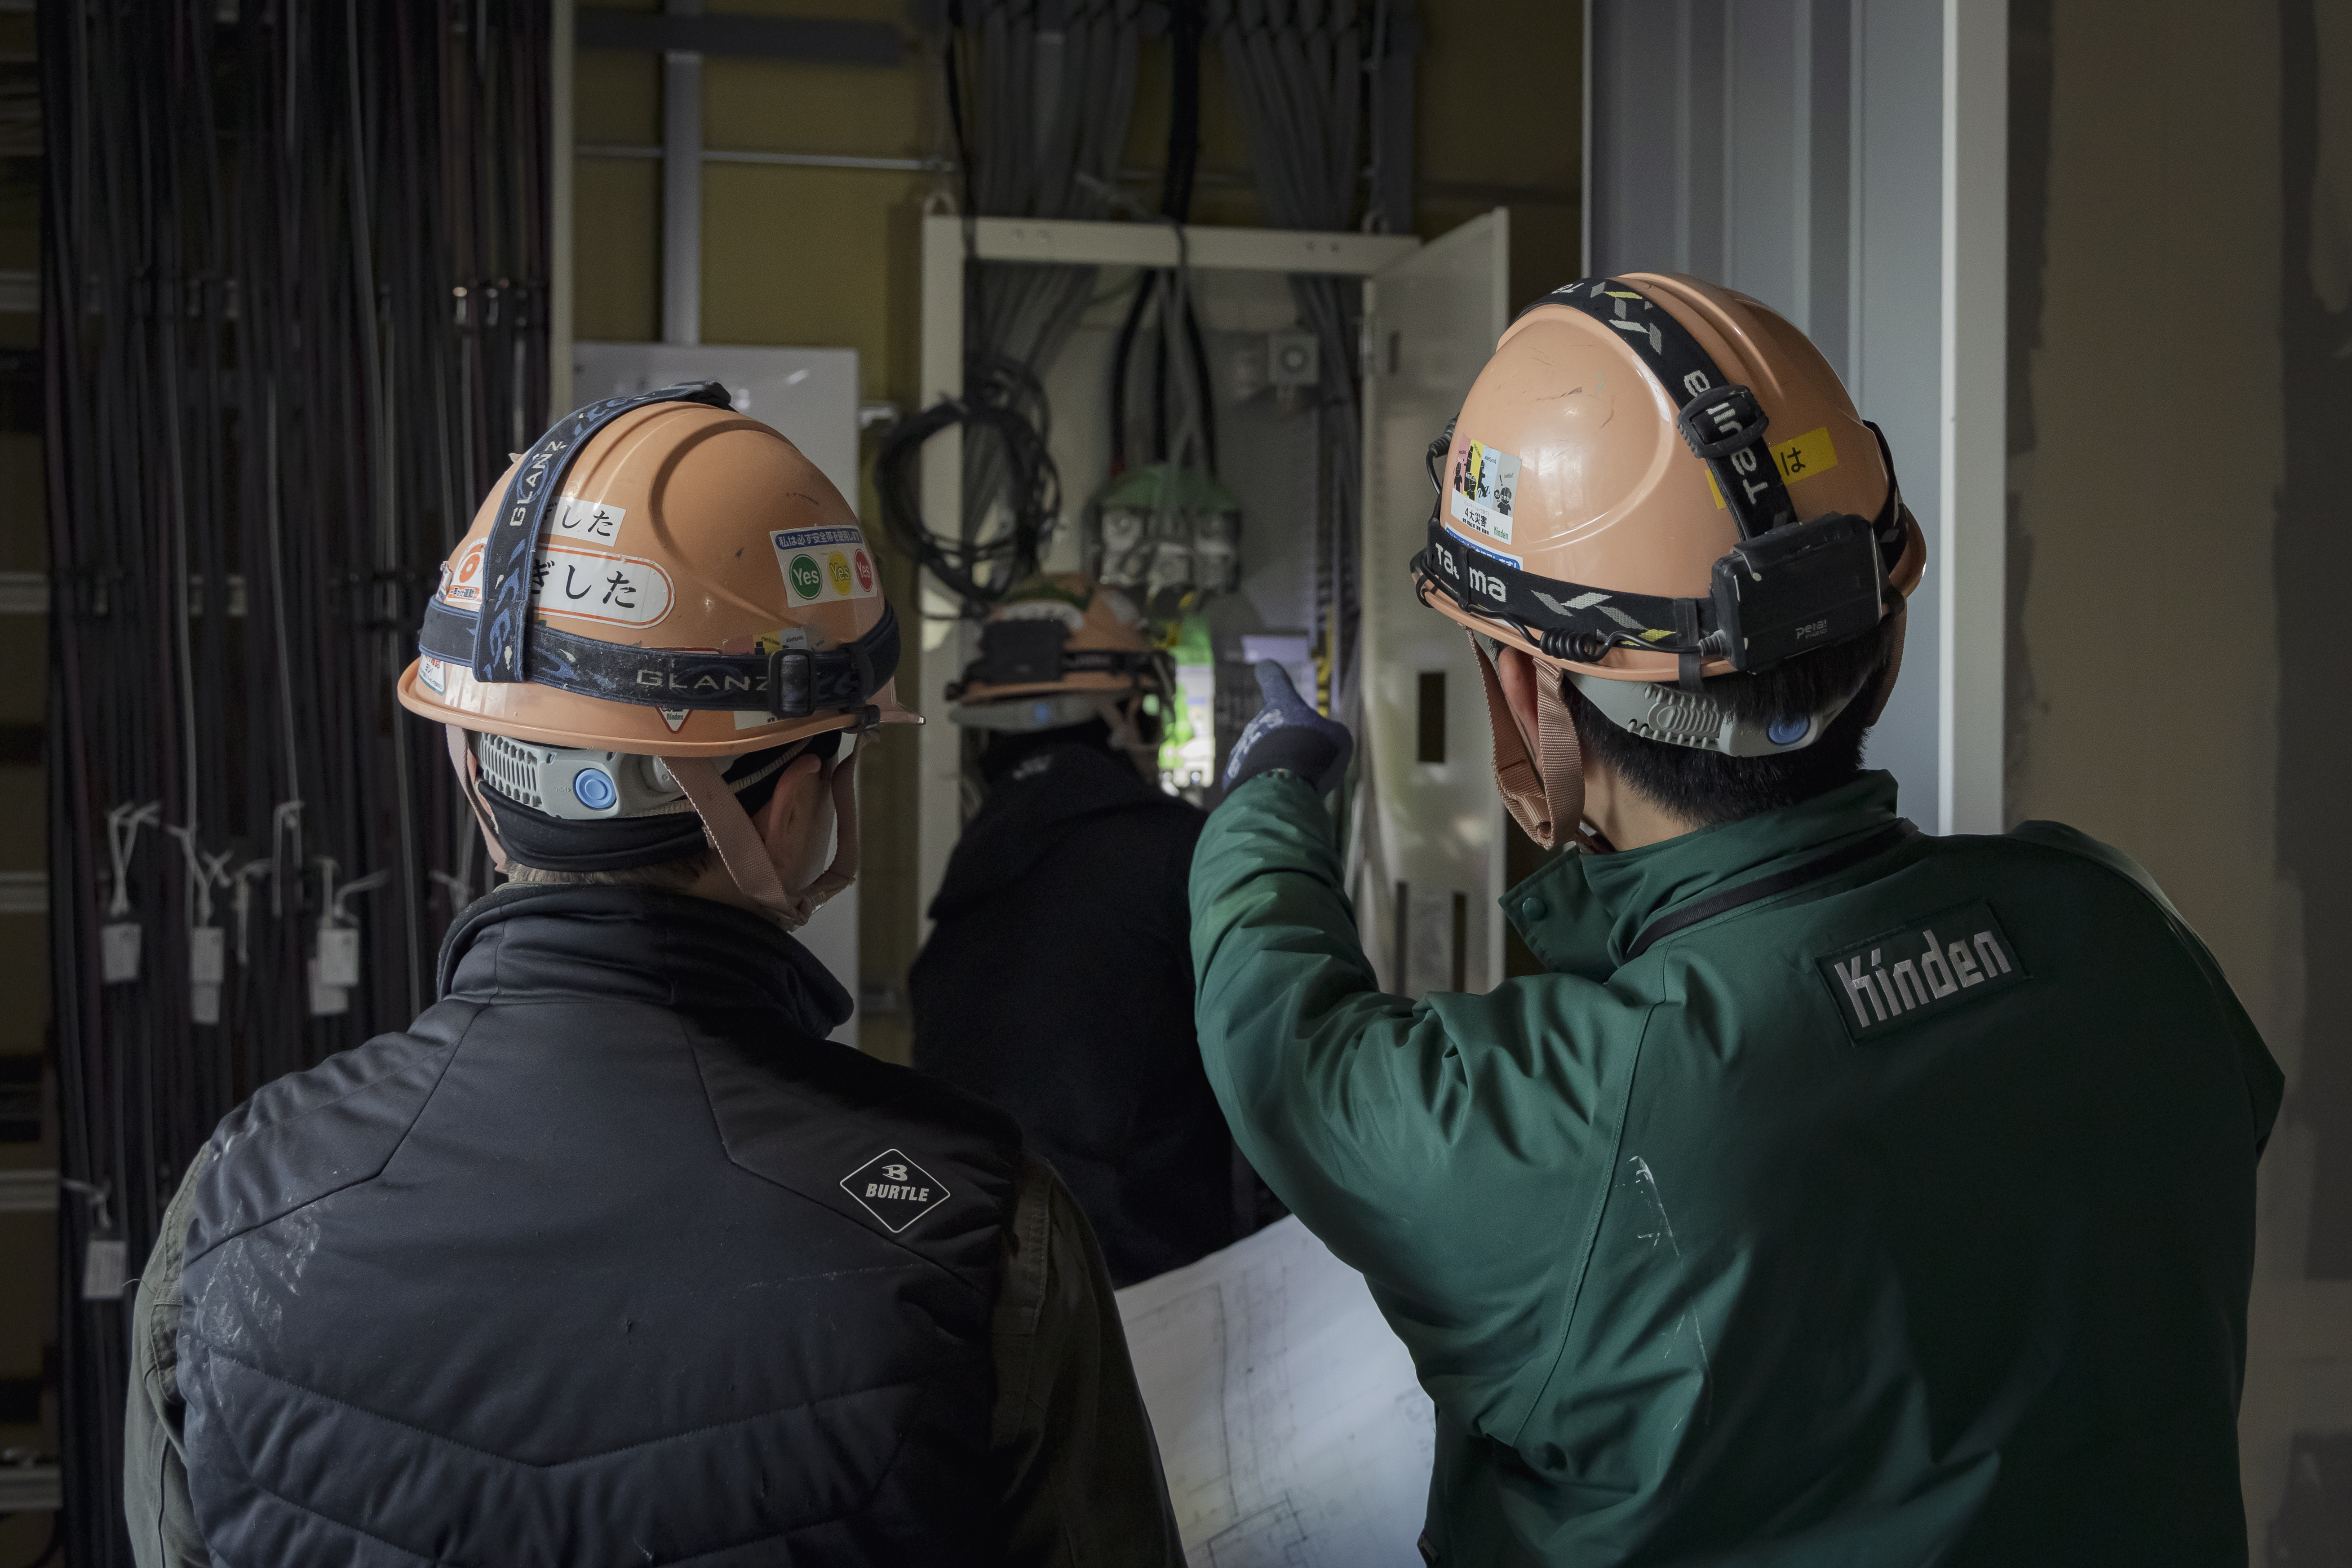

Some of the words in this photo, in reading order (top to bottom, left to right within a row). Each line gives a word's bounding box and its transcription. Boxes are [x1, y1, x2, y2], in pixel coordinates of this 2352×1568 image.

[1781, 447, 1806, 476] は
[510, 441, 564, 526] GLANZ
[1465, 507, 1487, 528] 4大災害
[1493, 526, 1509, 540] Kinden
[793, 567, 819, 586] Yes
[829, 562, 851, 582] Yes
[856, 562, 871, 578] Yes
[1834, 929, 2012, 1028] Kinden
[865, 1183, 930, 1201] BURTLE
